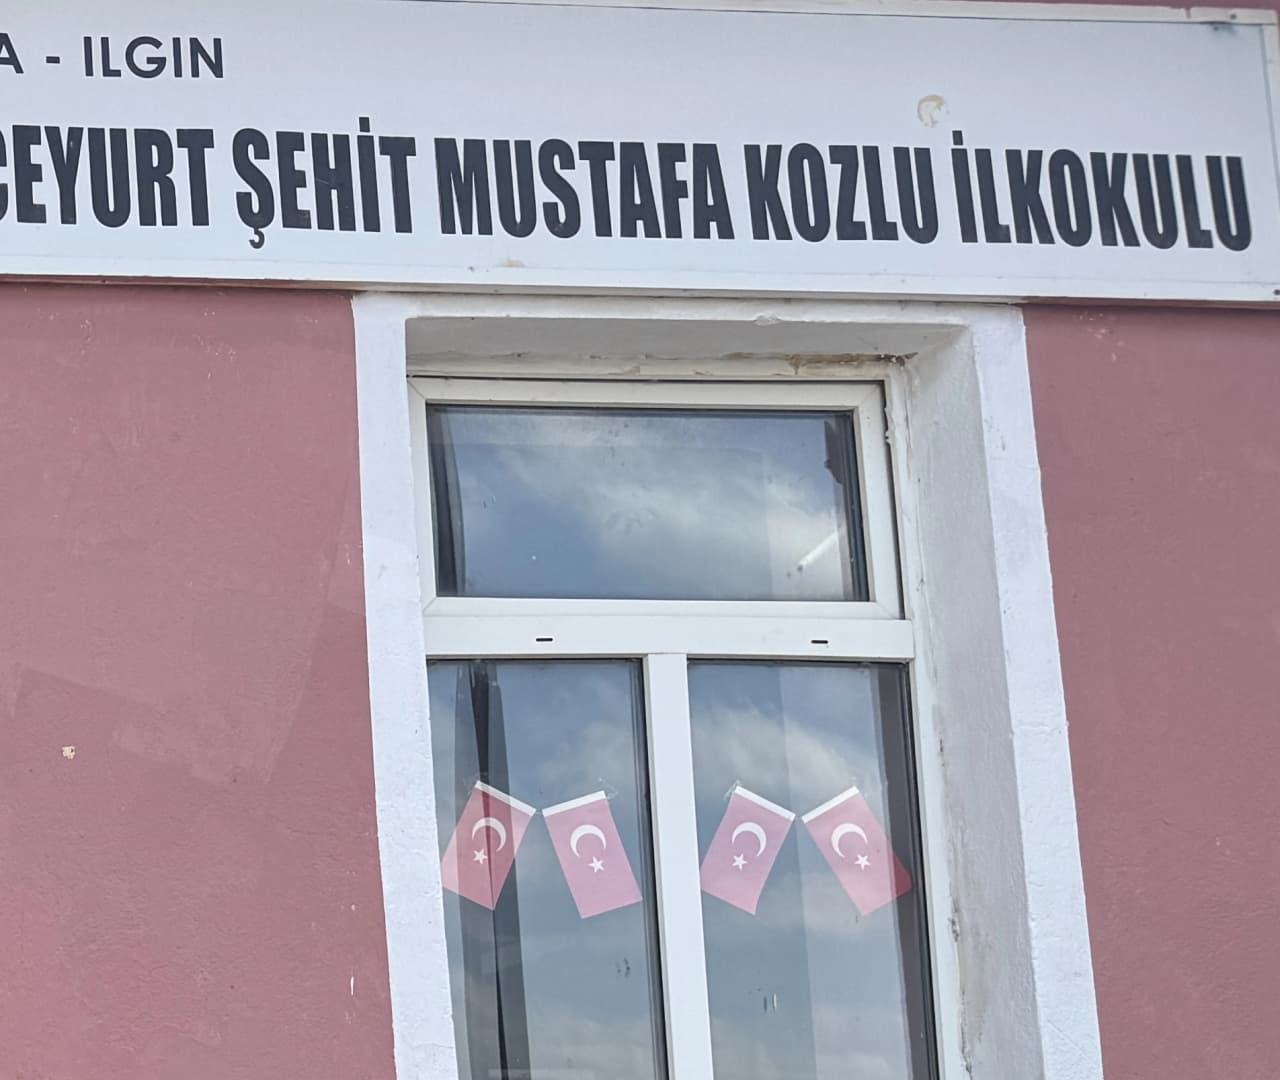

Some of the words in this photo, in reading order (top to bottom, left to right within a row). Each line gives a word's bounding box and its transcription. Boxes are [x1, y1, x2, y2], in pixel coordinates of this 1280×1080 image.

[83, 36, 224, 79] ILGIN
[232, 116, 417, 249] ŞEHİT
[434, 137, 735, 240] MUSTAFA
[743, 142, 939, 244] KOZLU
[951, 130, 1252, 252] İLKOKULU
